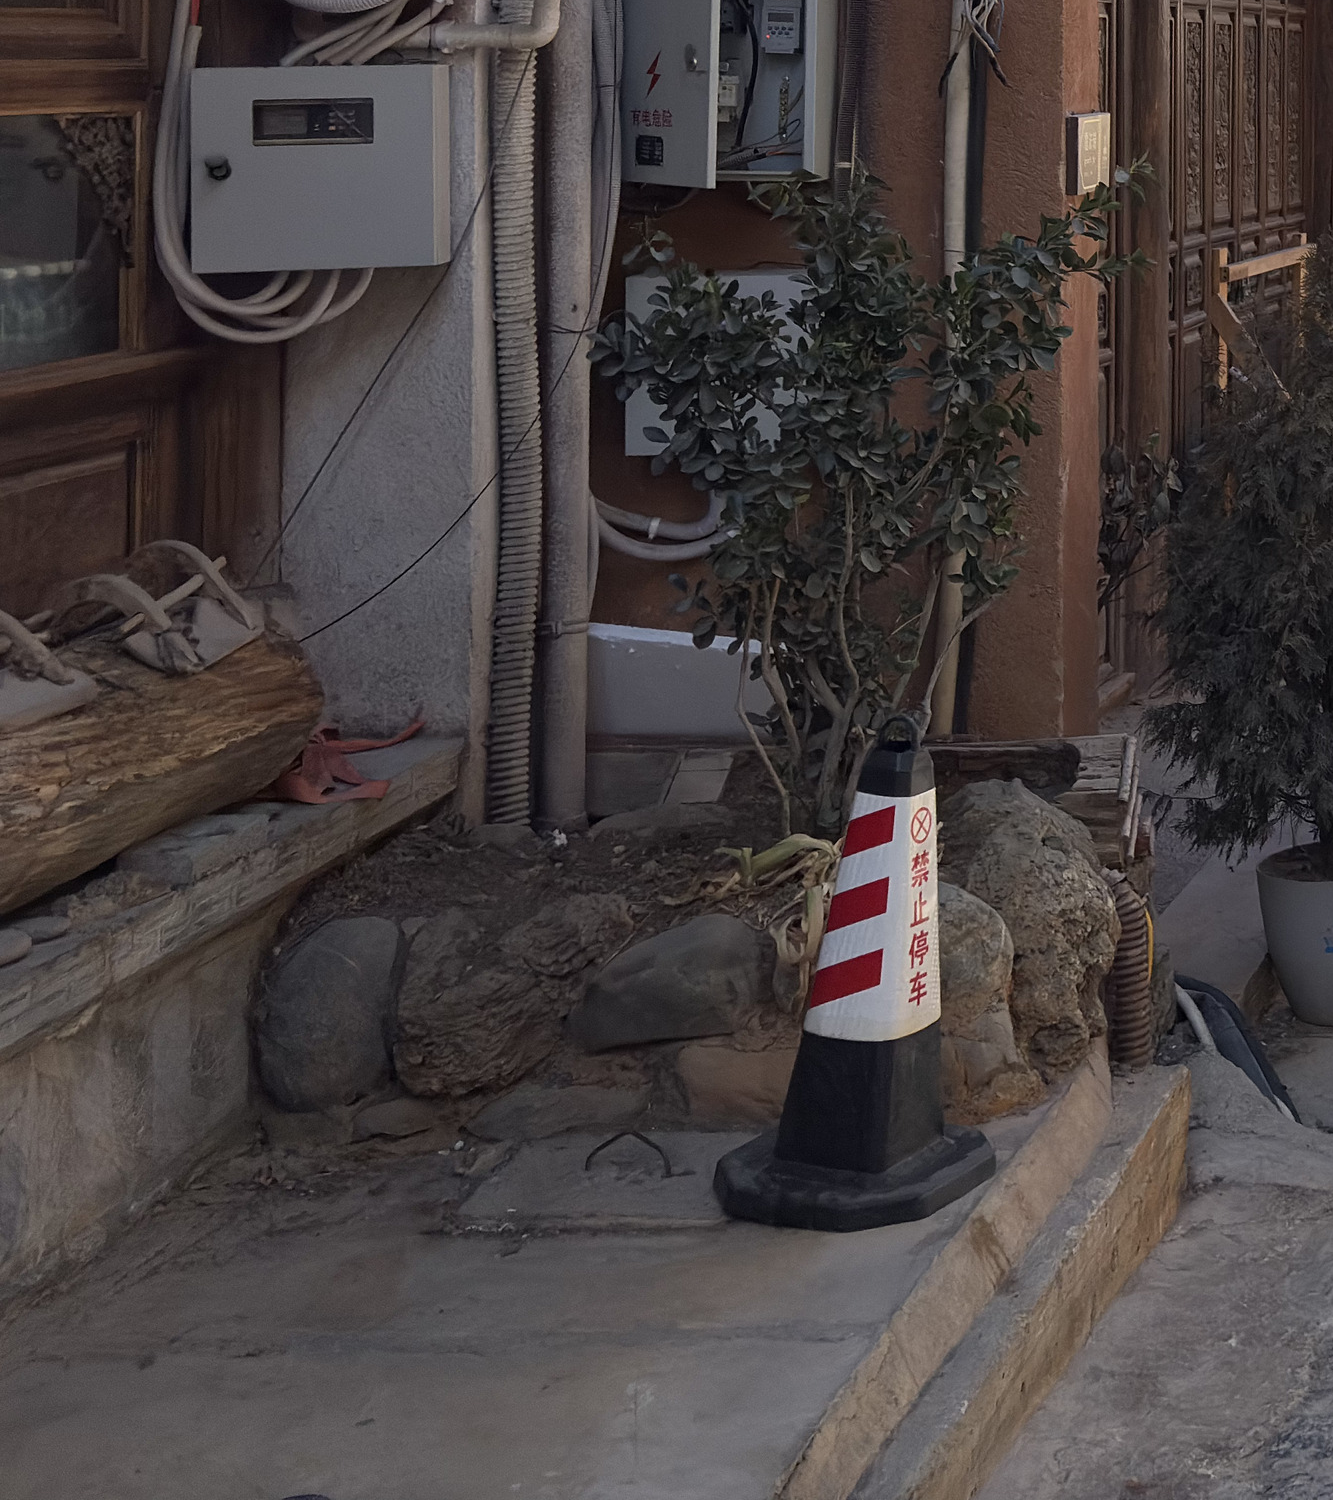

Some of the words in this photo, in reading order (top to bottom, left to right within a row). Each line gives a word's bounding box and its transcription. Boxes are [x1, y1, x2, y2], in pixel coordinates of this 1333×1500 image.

[629, 108, 673, 128] 有电危险
[907, 849, 931, 1007] 禁止停车
